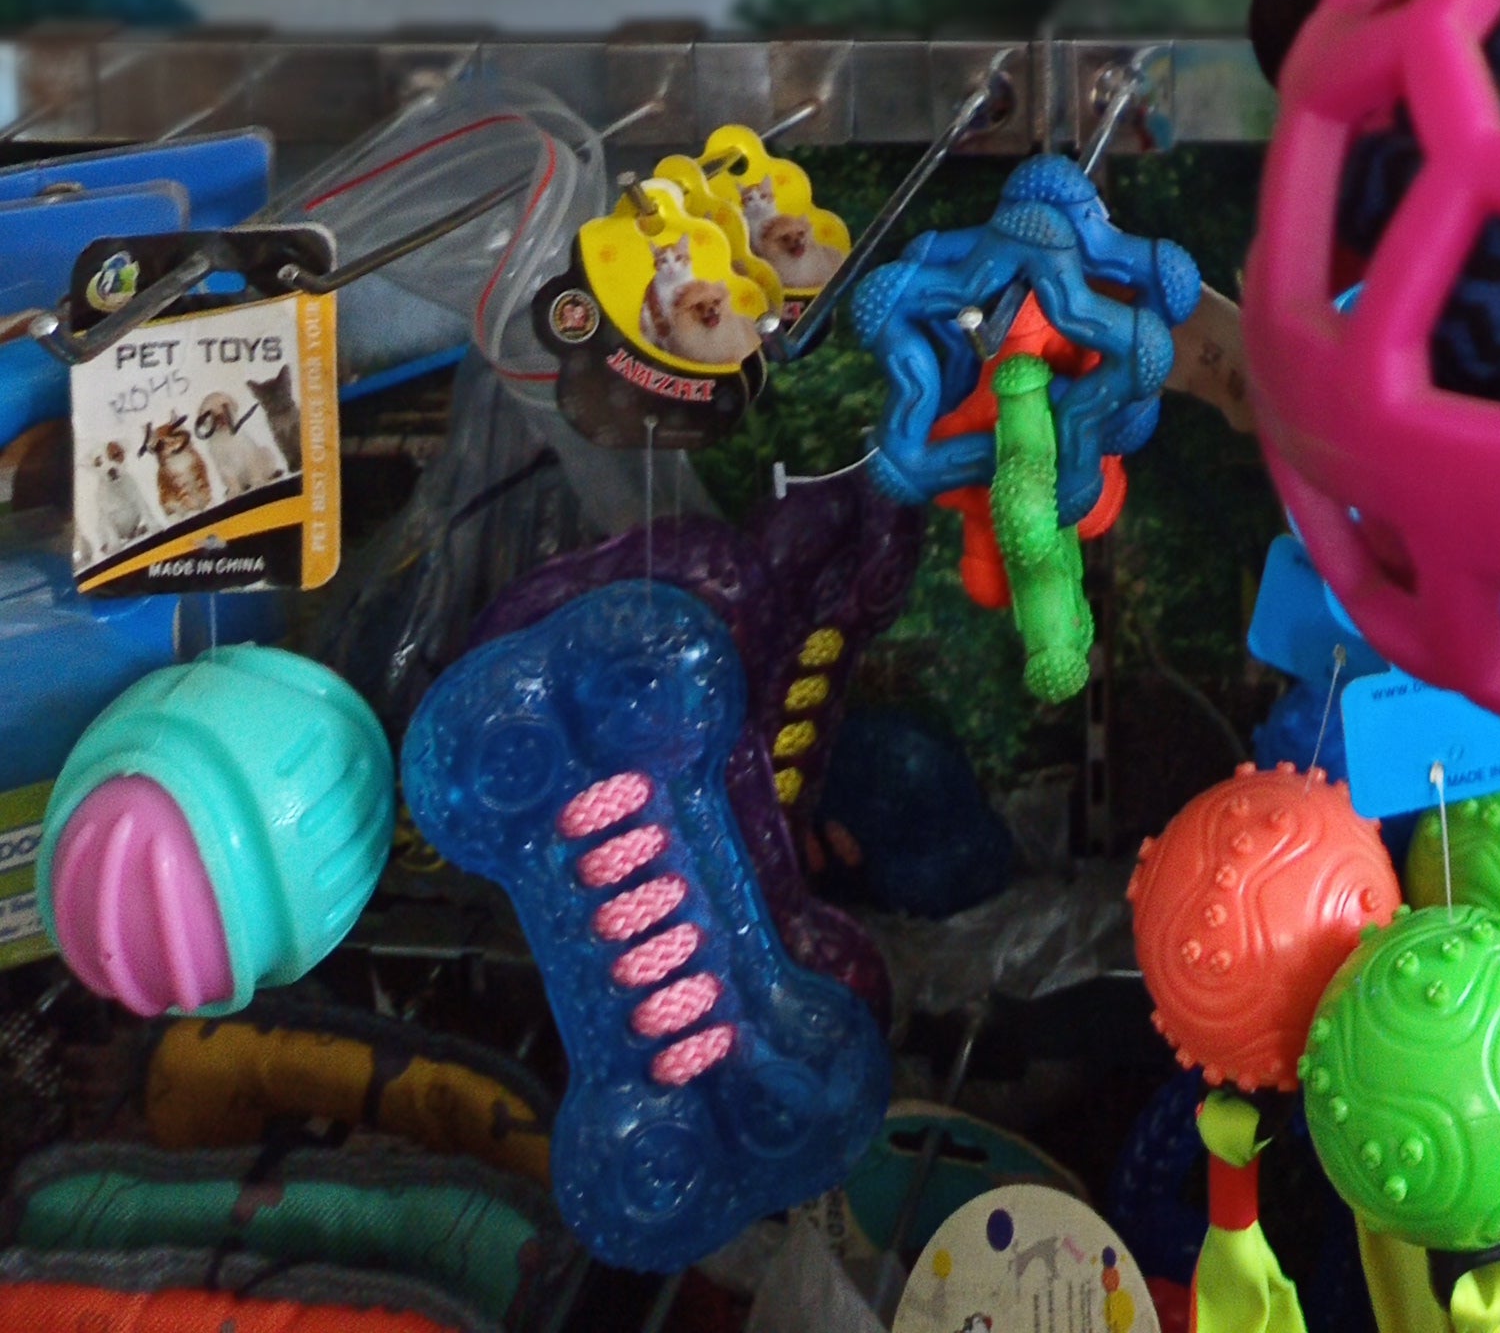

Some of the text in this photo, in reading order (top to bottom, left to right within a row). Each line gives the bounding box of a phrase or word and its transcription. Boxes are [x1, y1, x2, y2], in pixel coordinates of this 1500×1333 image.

[115, 335, 284, 370] PET TOYS
[305, 301, 326, 553] PET BEST CHOICE FOR YOUR
[148, 554, 267, 579] MADE IN CHINA
[1447, 768, 1486, 788] MADE
